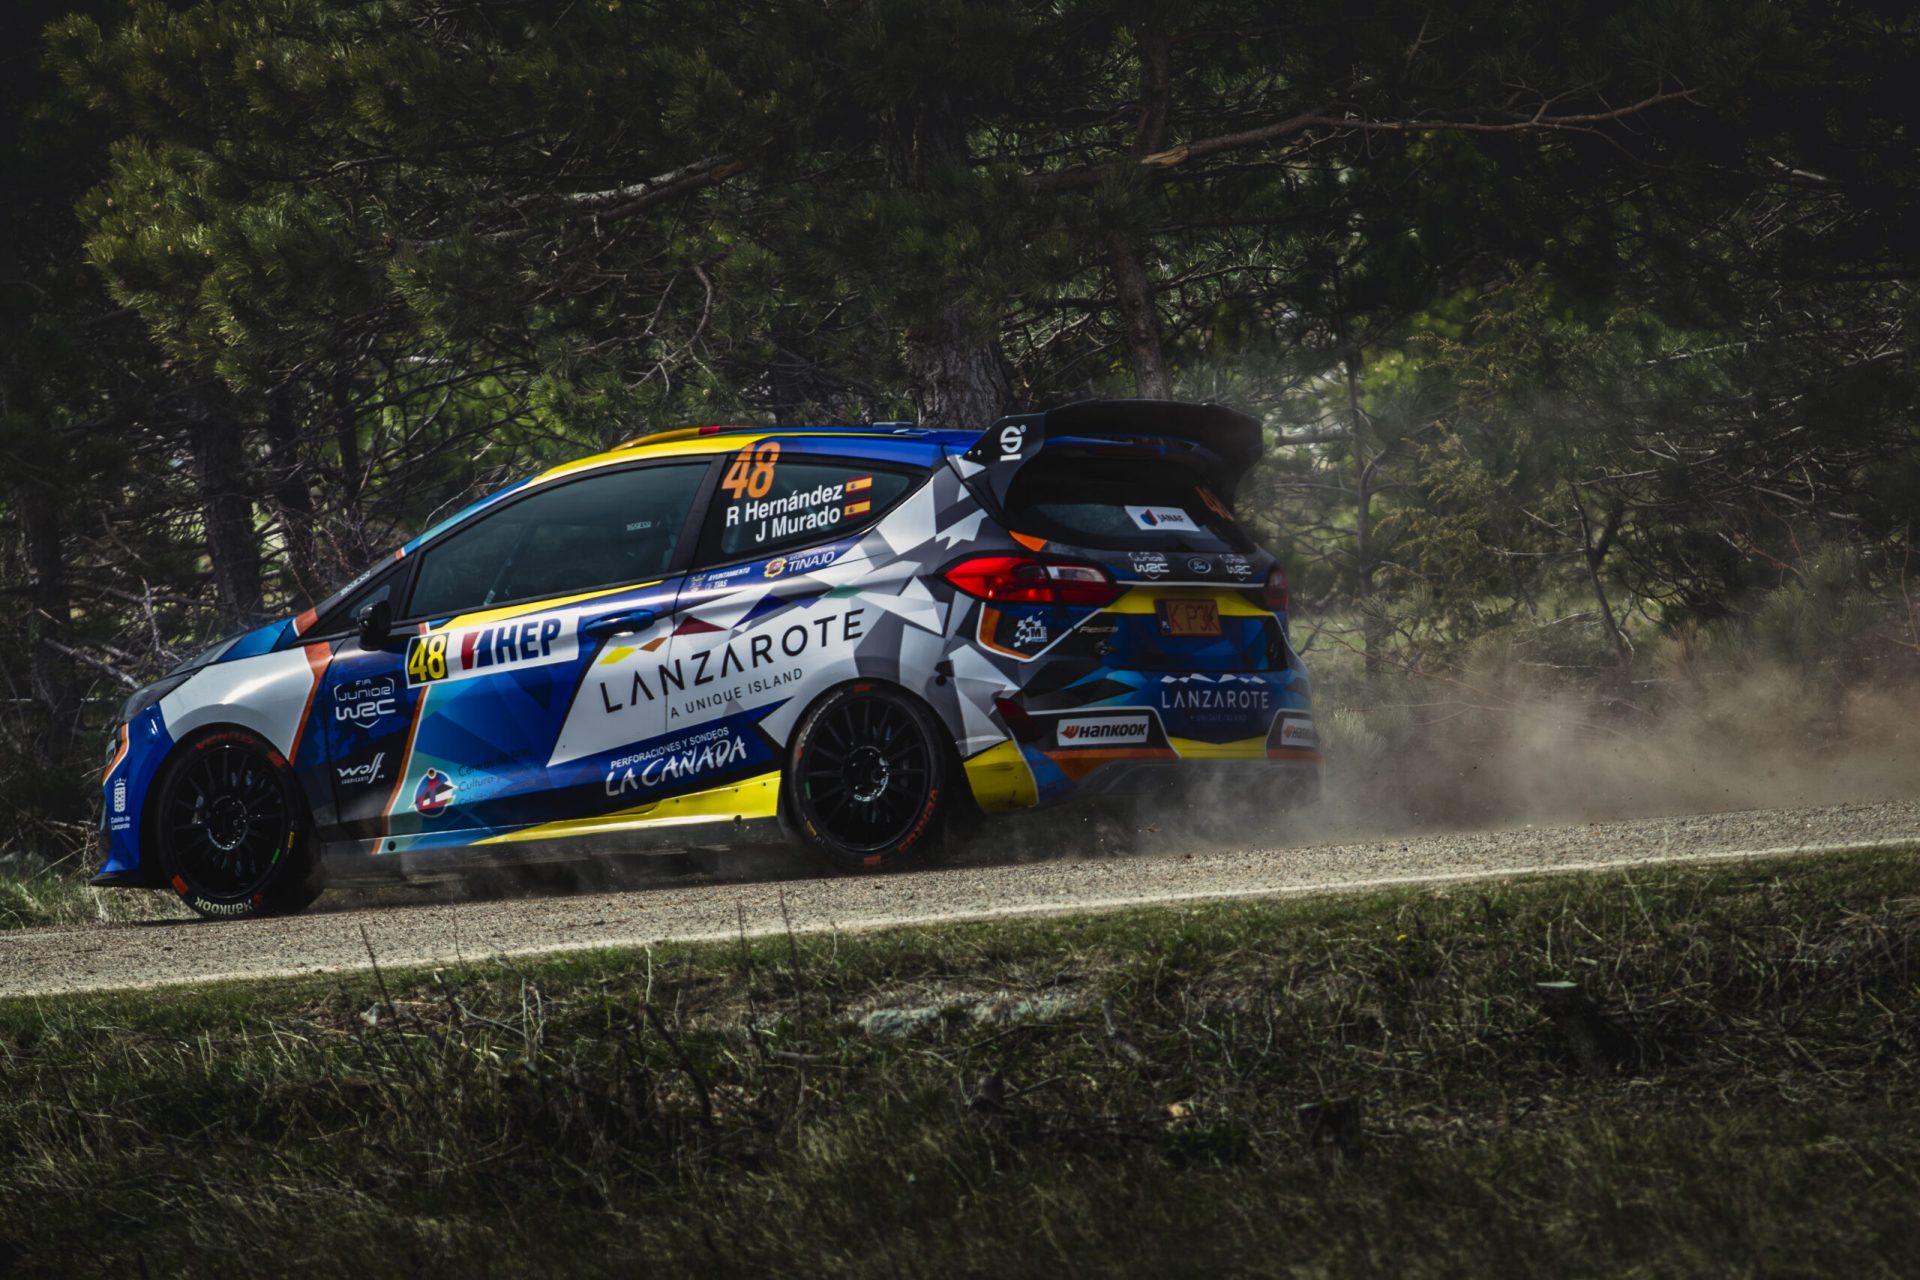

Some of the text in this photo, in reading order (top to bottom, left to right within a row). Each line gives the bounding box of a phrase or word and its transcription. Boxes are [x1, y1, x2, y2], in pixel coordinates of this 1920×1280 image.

[721, 441, 781, 500] 48
[726, 484, 844, 528] R Hernández
[755, 506, 841, 543] J Murado
[788, 551, 836, 572] TINAJO
[409, 618, 562, 682] 48 HEP
[600, 608, 865, 714] LANZAROTE
[338, 686, 392, 702] JUNIOR
[355, 679, 372, 687] FIA
[670, 667, 803, 719] A UNIQUE ISLAND
[1161, 690, 1270, 709] LANZAROTE
[336, 698, 396, 721] WRC
[605, 736, 747, 797] LA CAÑADA
[610, 727, 730, 770] PERFORACIONES Y SONDEOS
